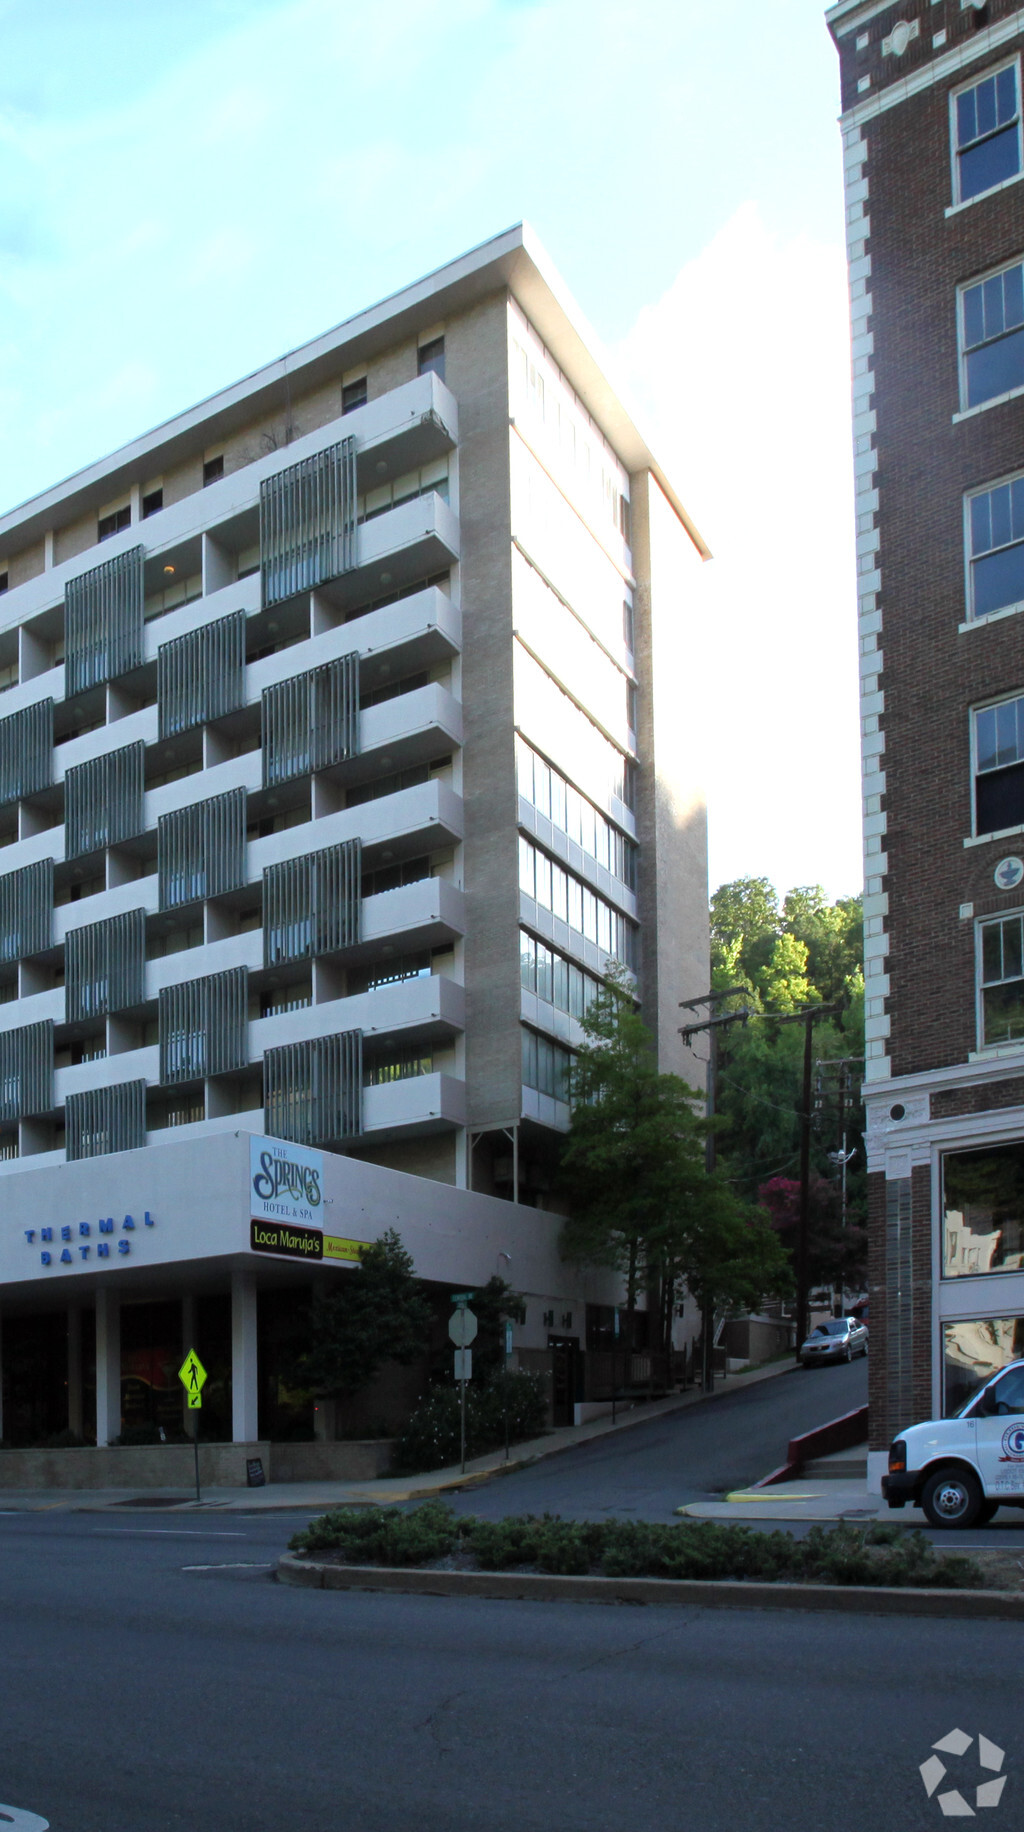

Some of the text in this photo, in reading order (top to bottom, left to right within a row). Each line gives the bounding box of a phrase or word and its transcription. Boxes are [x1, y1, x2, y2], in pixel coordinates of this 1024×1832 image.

[272, 1147, 287, 1159] THE
[253, 1151, 321, 1206] SPRINGS
[263, 1201, 313, 1220] HOTEL & SPA
[24, 1211, 155, 1244] THERMAL
[254, 1226, 320, 1254] Loca Maruja's
[40, 1239, 131, 1266] BATHS
